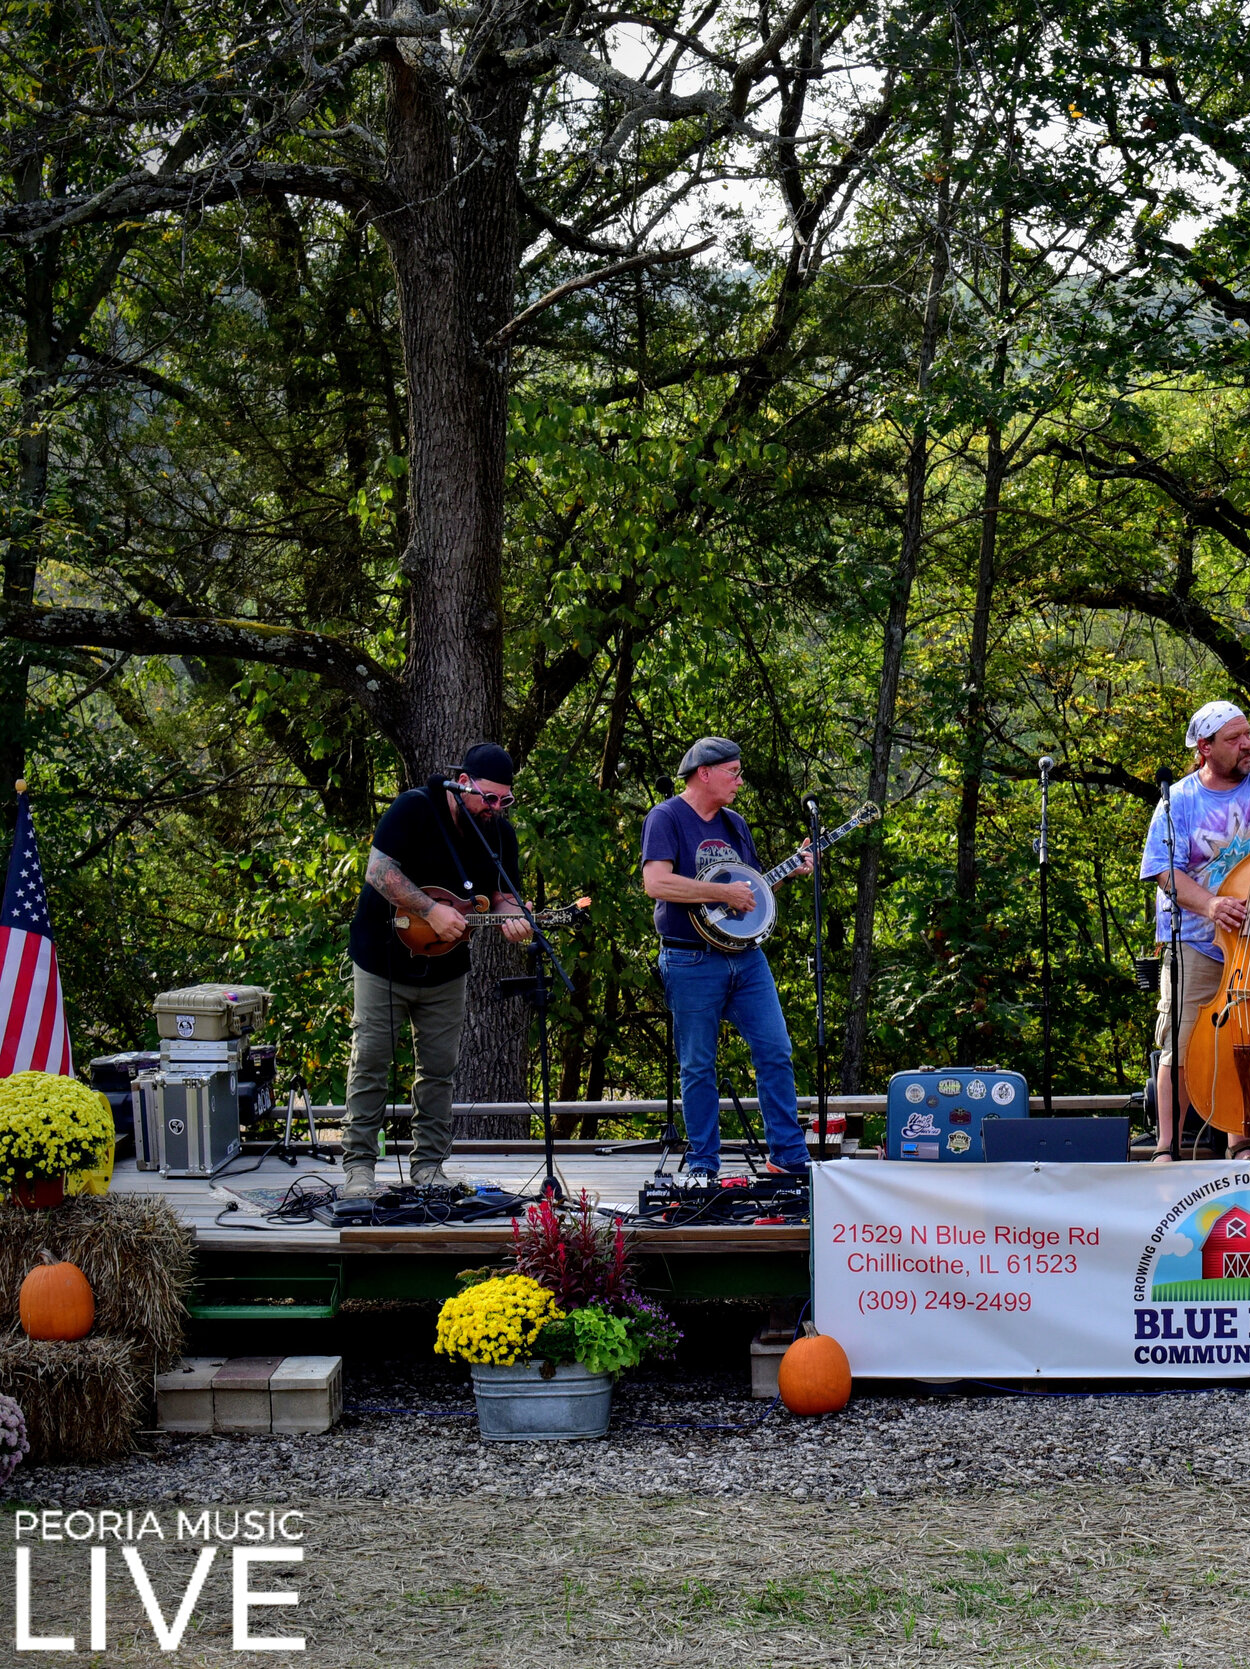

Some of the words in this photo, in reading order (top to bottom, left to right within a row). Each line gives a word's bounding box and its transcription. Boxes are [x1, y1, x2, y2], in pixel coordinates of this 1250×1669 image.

[832, 1223, 903, 1244] 21529
[911, 1225, 927, 1245] N
[936, 1225, 986, 1245] Blue
[994, 1226, 1060, 1249] Ridge
[1068, 1227, 1099, 1246] Rd
[1133, 1245, 1156, 1302] GROWING
[1151, 1177, 1230, 1243] OPPORTUNITIES
[847, 1252, 970, 1277] Chillicothe,
[980, 1254, 999, 1274] IL
[1007, 1254, 1078, 1274] 61523
[858, 1289, 917, 1316] (309)
[925, 1290, 1032, 1312] 249-2499
[1134, 1307, 1238, 1340] BLUE
